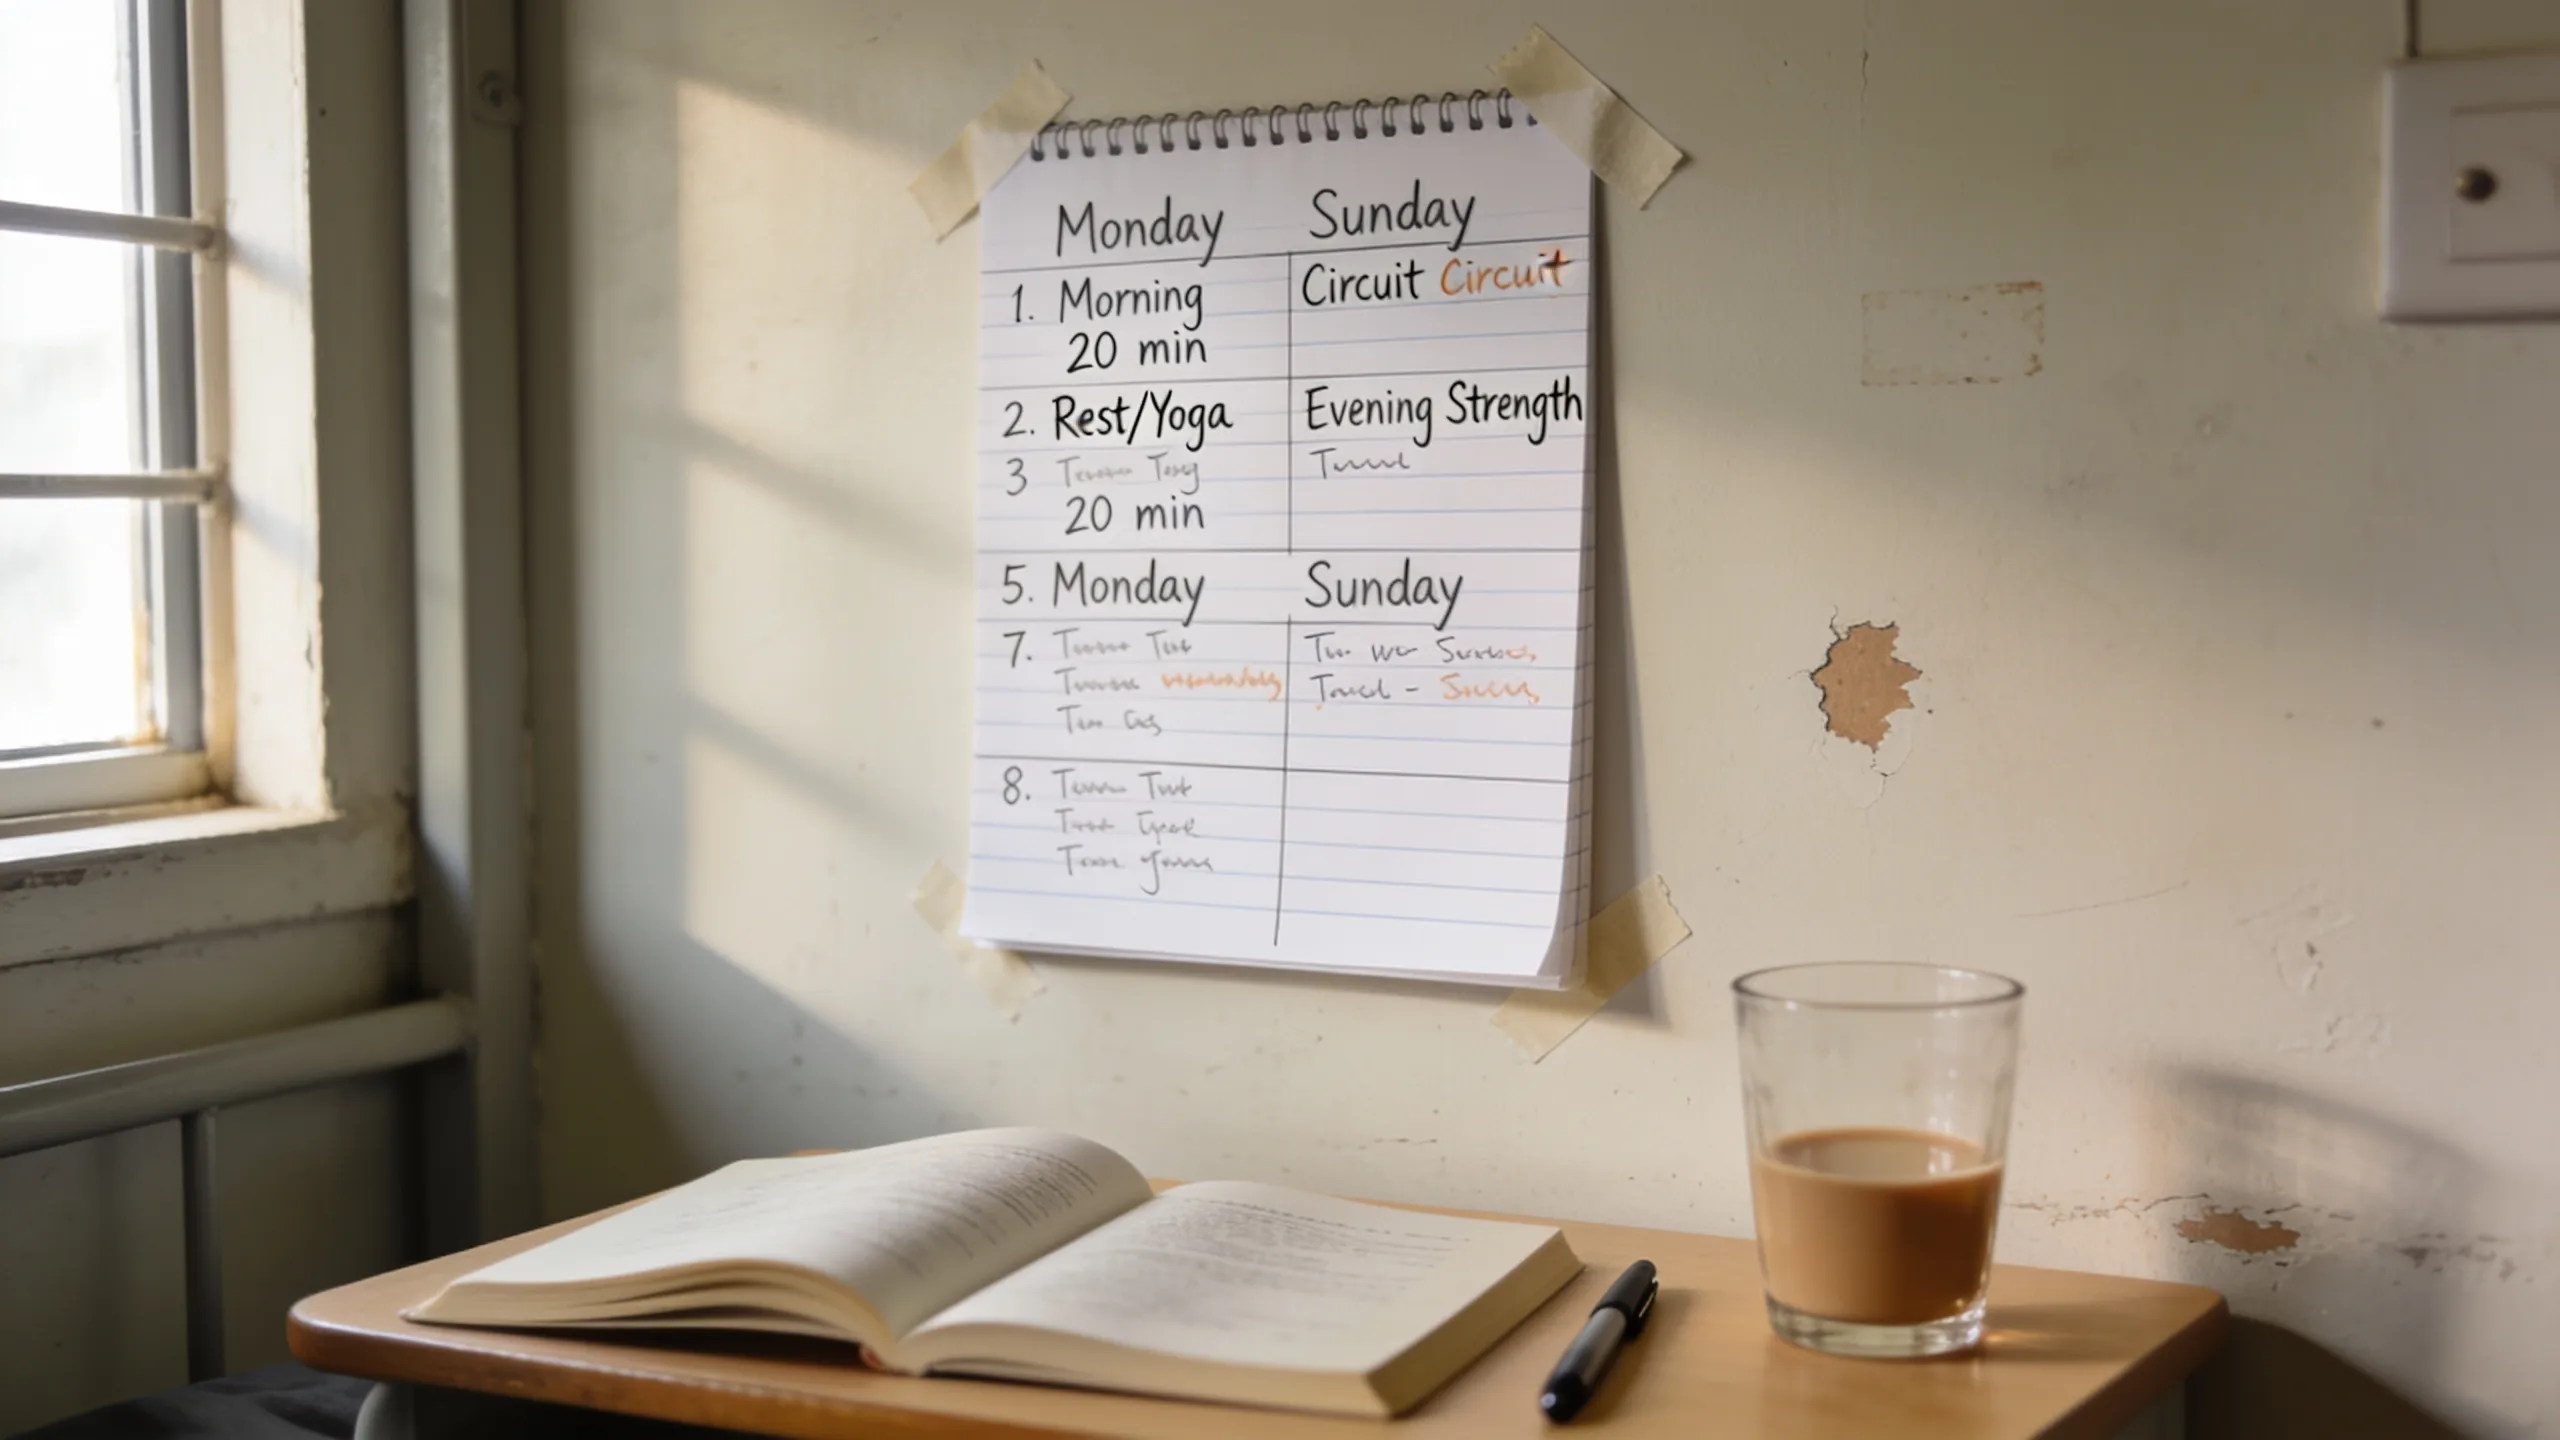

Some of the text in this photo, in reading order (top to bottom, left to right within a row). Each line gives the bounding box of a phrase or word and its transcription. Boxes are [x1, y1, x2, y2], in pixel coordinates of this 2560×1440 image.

[1056, 195, 1224, 267] Monday
[1310, 179, 1475, 251] Sunday
[1011, 277, 1202, 330] 1. Morning
[1302, 249, 1571, 305] Circuit Circuit
[1067, 332, 1206, 372] 20 min
[1003, 388, 1233, 451] 2. Rest/Yoga
[1305, 375, 1583, 447] Evening Strength
[1006, 457, 1028, 495] 3
[1065, 495, 1204, 534] 20 min
[1002, 558, 1204, 627] 5. Monday
[1304, 557, 1463, 631] Sunday
[1003, 630, 1031, 667] 7.
[1002, 765, 1030, 804] 8.
